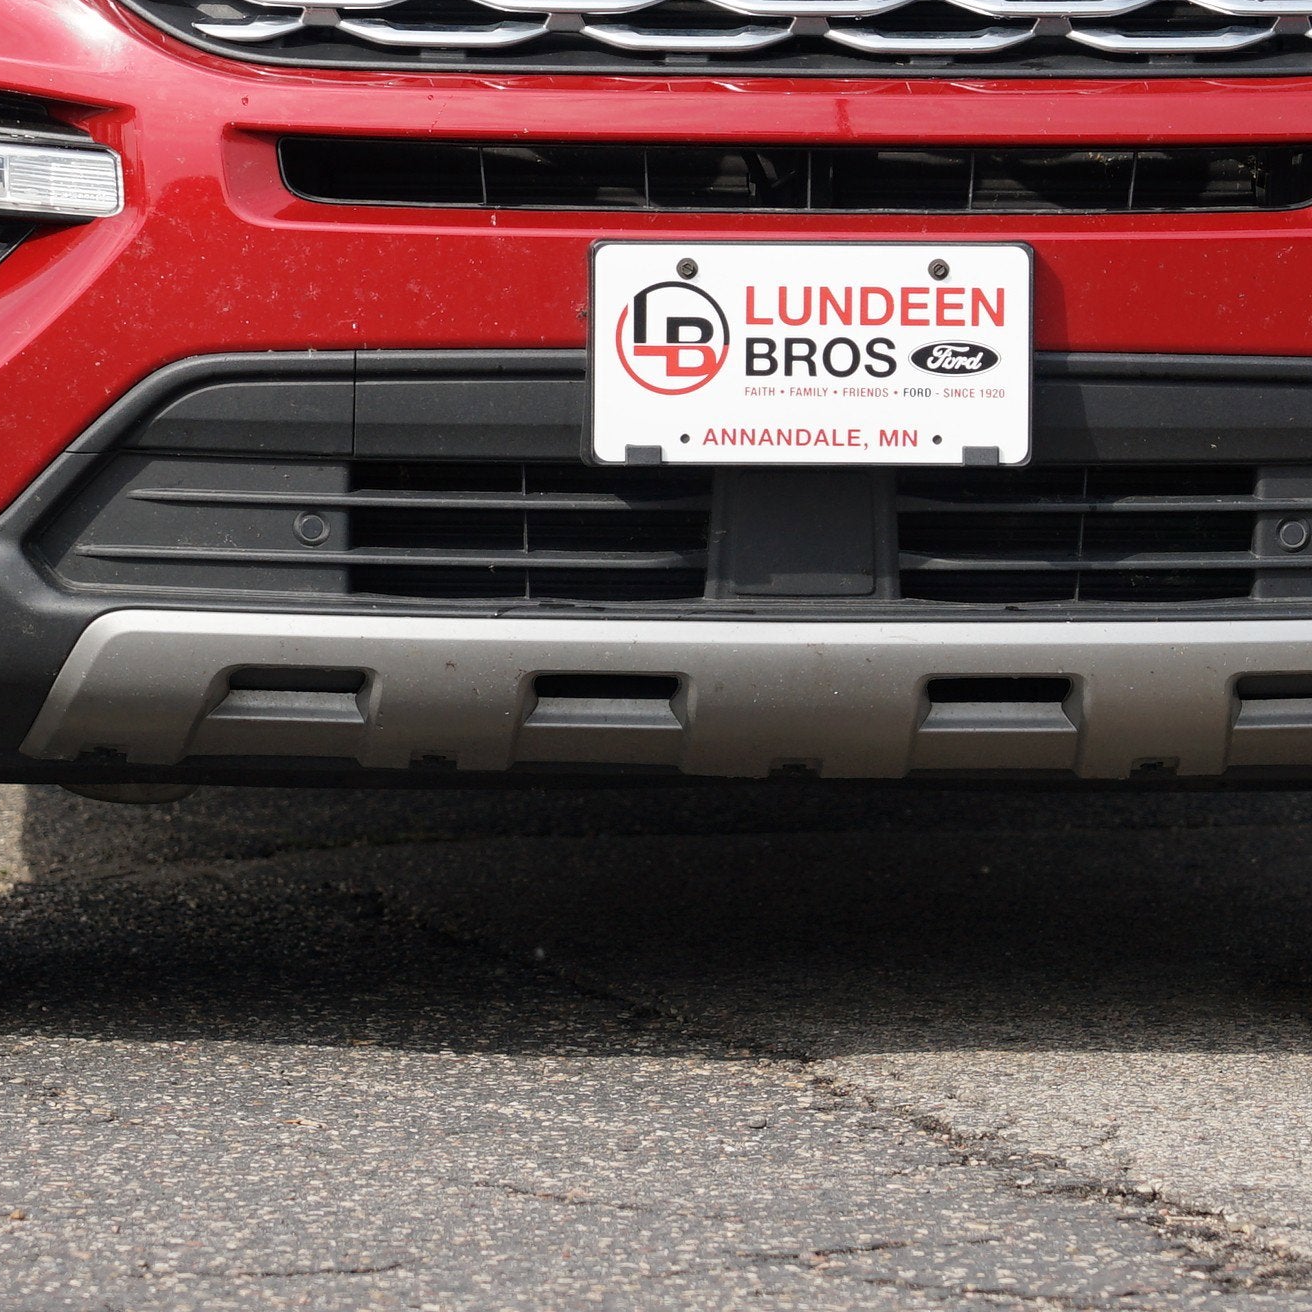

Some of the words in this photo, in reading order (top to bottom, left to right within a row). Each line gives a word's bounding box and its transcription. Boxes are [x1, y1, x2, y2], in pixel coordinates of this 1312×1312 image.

[745, 285, 1005, 328] LUNDEEN
[744, 336, 898, 379] BROS
[926, 345, 982, 371] Ford
[744, 386, 776, 397] FAITH
[789, 386, 829, 397] FAMILY
[842, 387, 889, 398] FRIENDS
[903, 387, 932, 398] FORD
[943, 387, 975, 399] SINCE
[979, 388, 1005, 399] 1920
[702, 427, 869, 451] ANNANDALE,
[879, 428, 919, 448] MN
